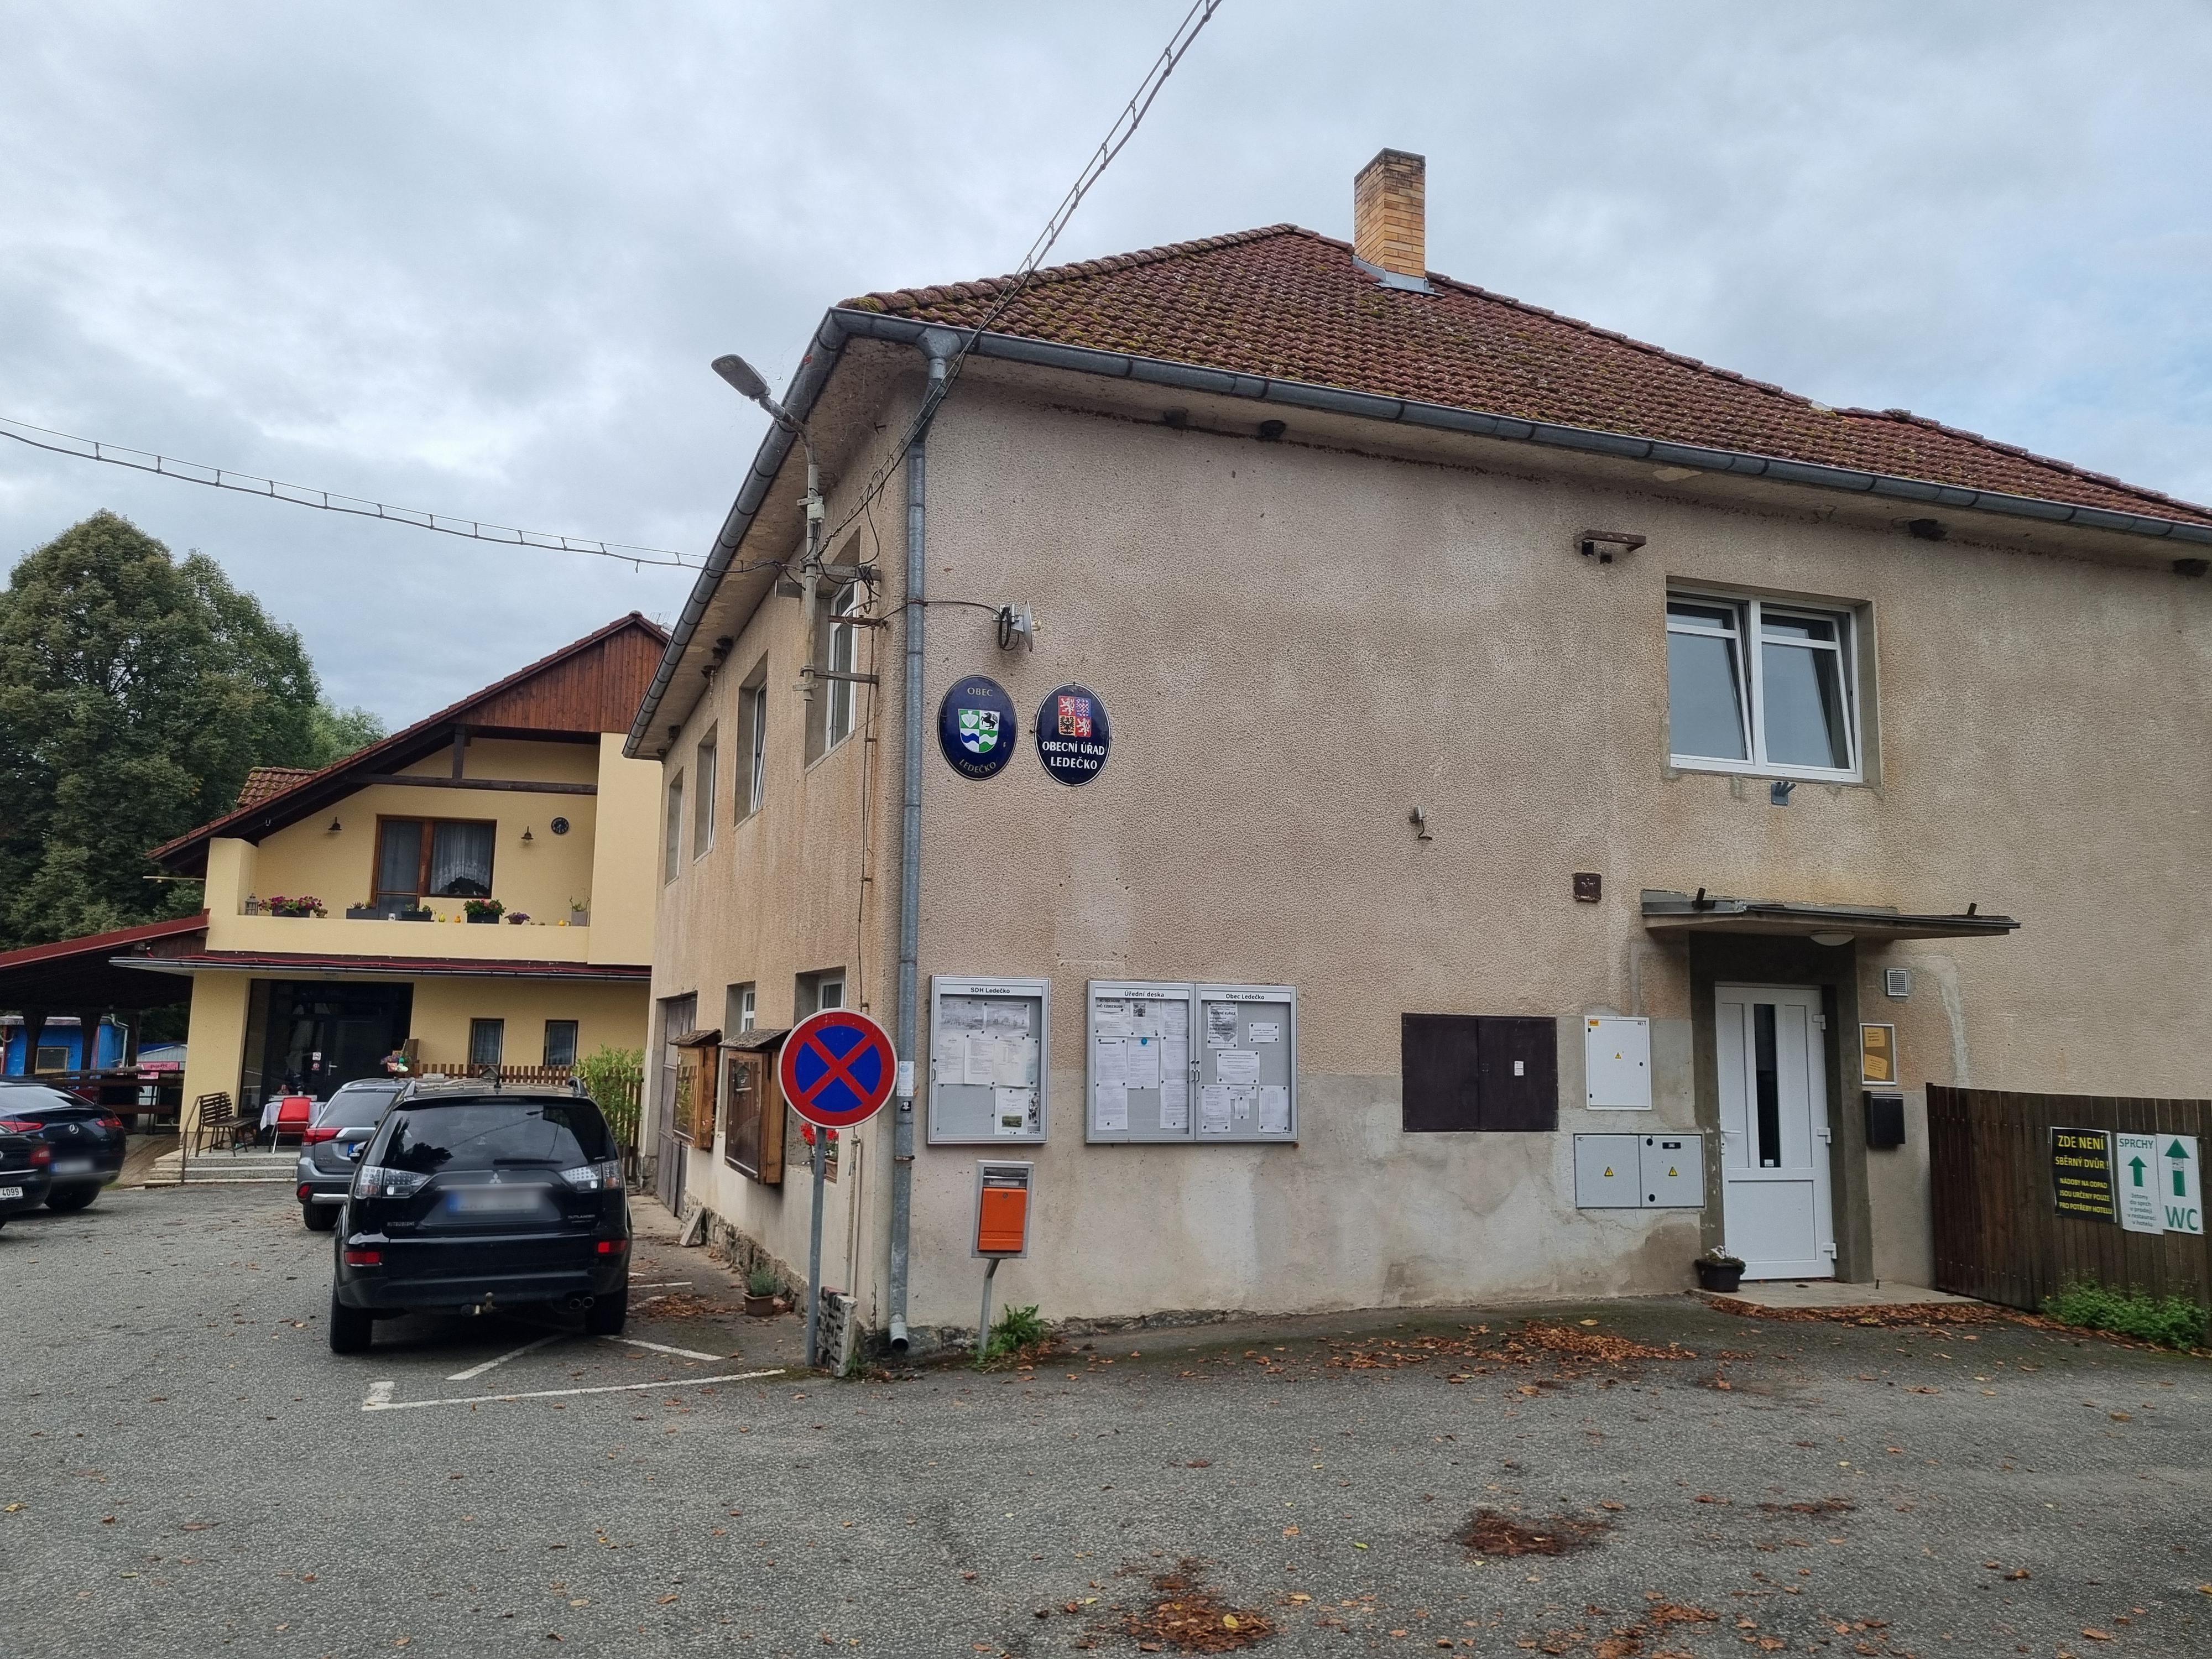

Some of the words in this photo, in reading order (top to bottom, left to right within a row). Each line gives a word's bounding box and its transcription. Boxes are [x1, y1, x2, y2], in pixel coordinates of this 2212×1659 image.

[967, 687, 993, 697] OBEC
[1042, 741, 1077, 753] OBECNÍ
[1081, 742, 1105, 755] ÚŘAD
[958, 759, 996, 773] LEDEČKO
[1050, 757, 1098, 770] LEDEČKO
[2058, 1135, 2077, 1148] ZDE
[2079, 1135, 2104, 1150] NENÍ
[2119, 1138, 2153, 1149] SPRCHY
[2056, 1155, 2082, 1167] SBĚRNÝ
[2084, 1157, 2105, 1169] DVŮR
[2059, 1177, 2080, 1186] NÁDOBY
[2, 1188, 19, 1196] 4099
[2073, 1190, 2092, 1199] URČENY
[2070, 1203, 2091, 1212] POTŘEBY
[2093, 1206, 2112, 1214] HOTELU
[2165, 1205, 2198, 1231] WC
